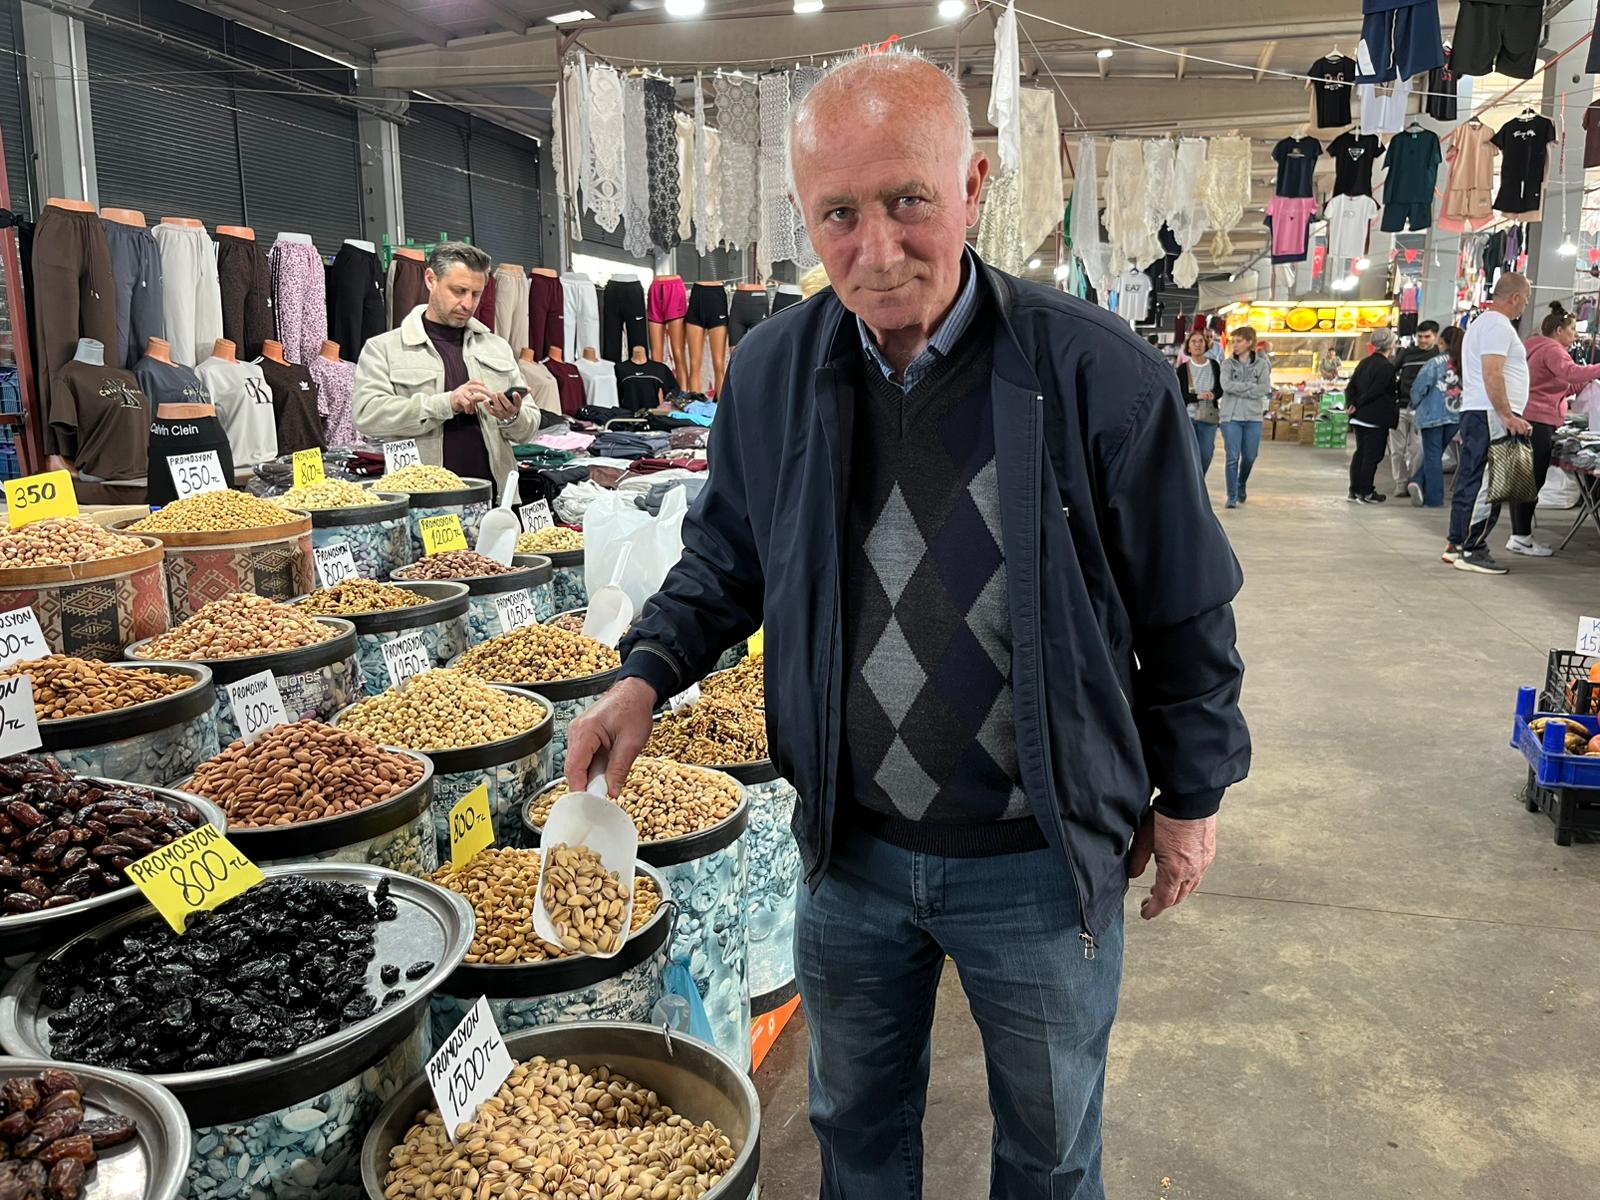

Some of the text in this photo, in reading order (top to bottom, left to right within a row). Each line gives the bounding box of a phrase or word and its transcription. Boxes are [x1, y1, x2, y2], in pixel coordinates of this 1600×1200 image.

[171, 424, 199, 436] Clein
[169, 453, 212, 466] PROMOSYON
[301, 462, 316, 485] 800
[393, 453, 410, 471] 800
[179, 465, 210, 495] 350
[15, 483, 56, 508] 350
[431, 528, 454, 549] 1200
[323, 561, 345, 587] 800
[507, 603, 528, 630] 1250
[394, 654, 420, 687] 1250
[245, 702, 269, 733] 800
[454, 806, 475, 844] 800
[131, 825, 220, 883] PROMOSYON
[170, 850, 249, 906] 800 TL
[430, 1003, 480, 1088] PROMOSYON
[448, 1046, 485, 1117] 1500
